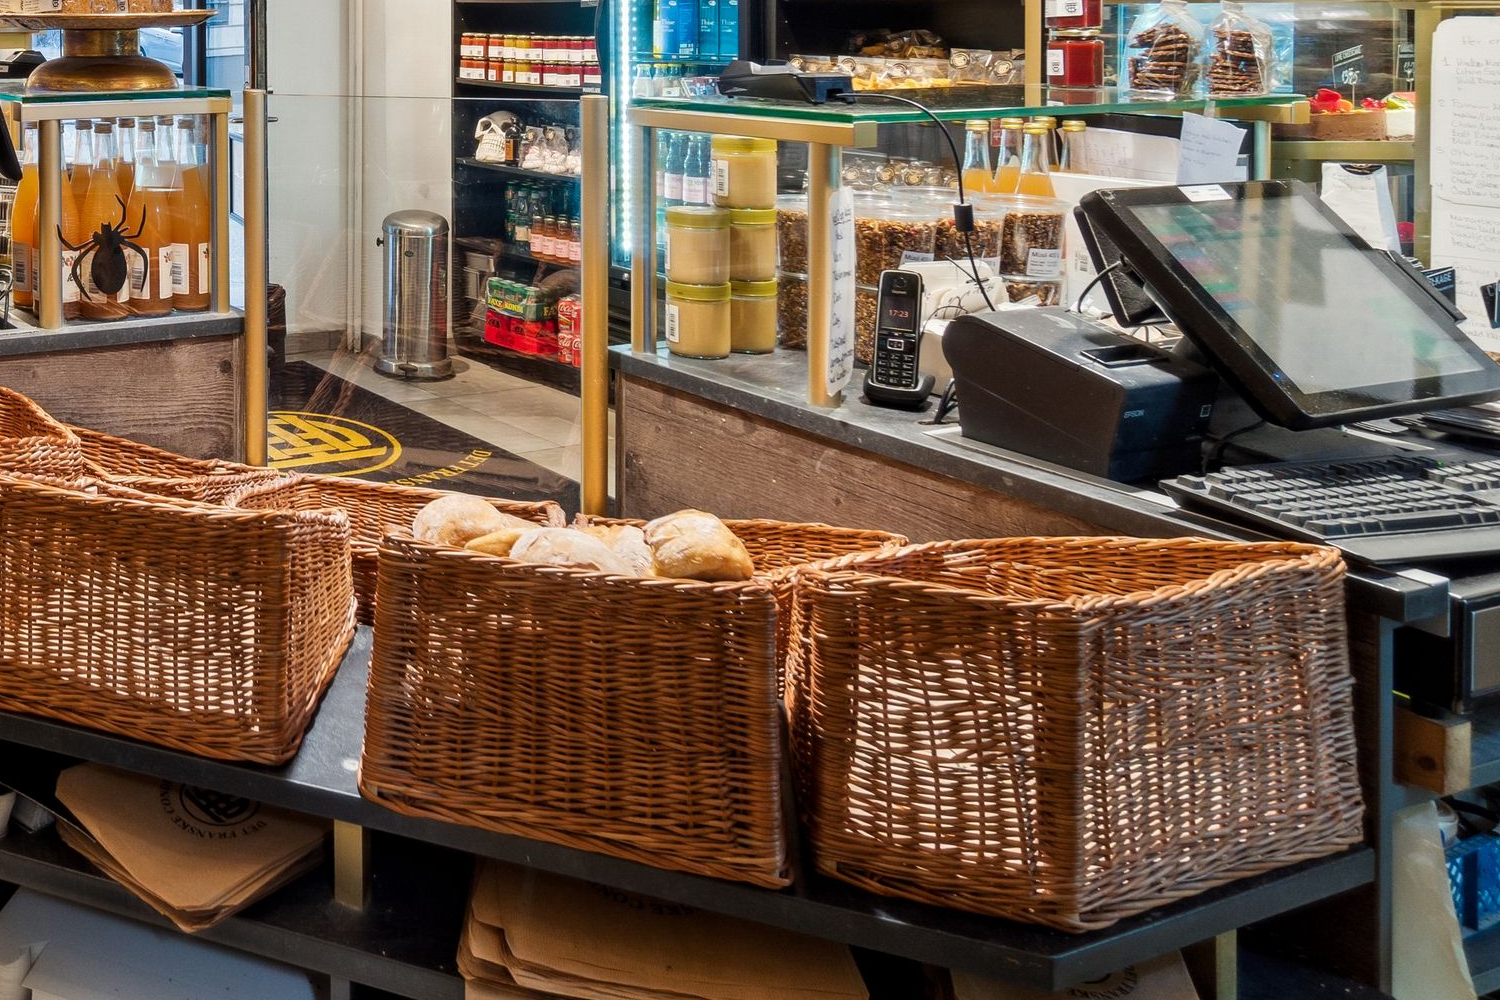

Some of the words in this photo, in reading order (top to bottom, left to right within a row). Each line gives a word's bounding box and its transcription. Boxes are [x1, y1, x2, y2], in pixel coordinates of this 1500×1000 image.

[888, 309, 909, 318] 17:23
[1123, 408, 1145, 419] EPSON
[457, 449, 492, 468] DET
[388, 465, 469, 487] FRANS
